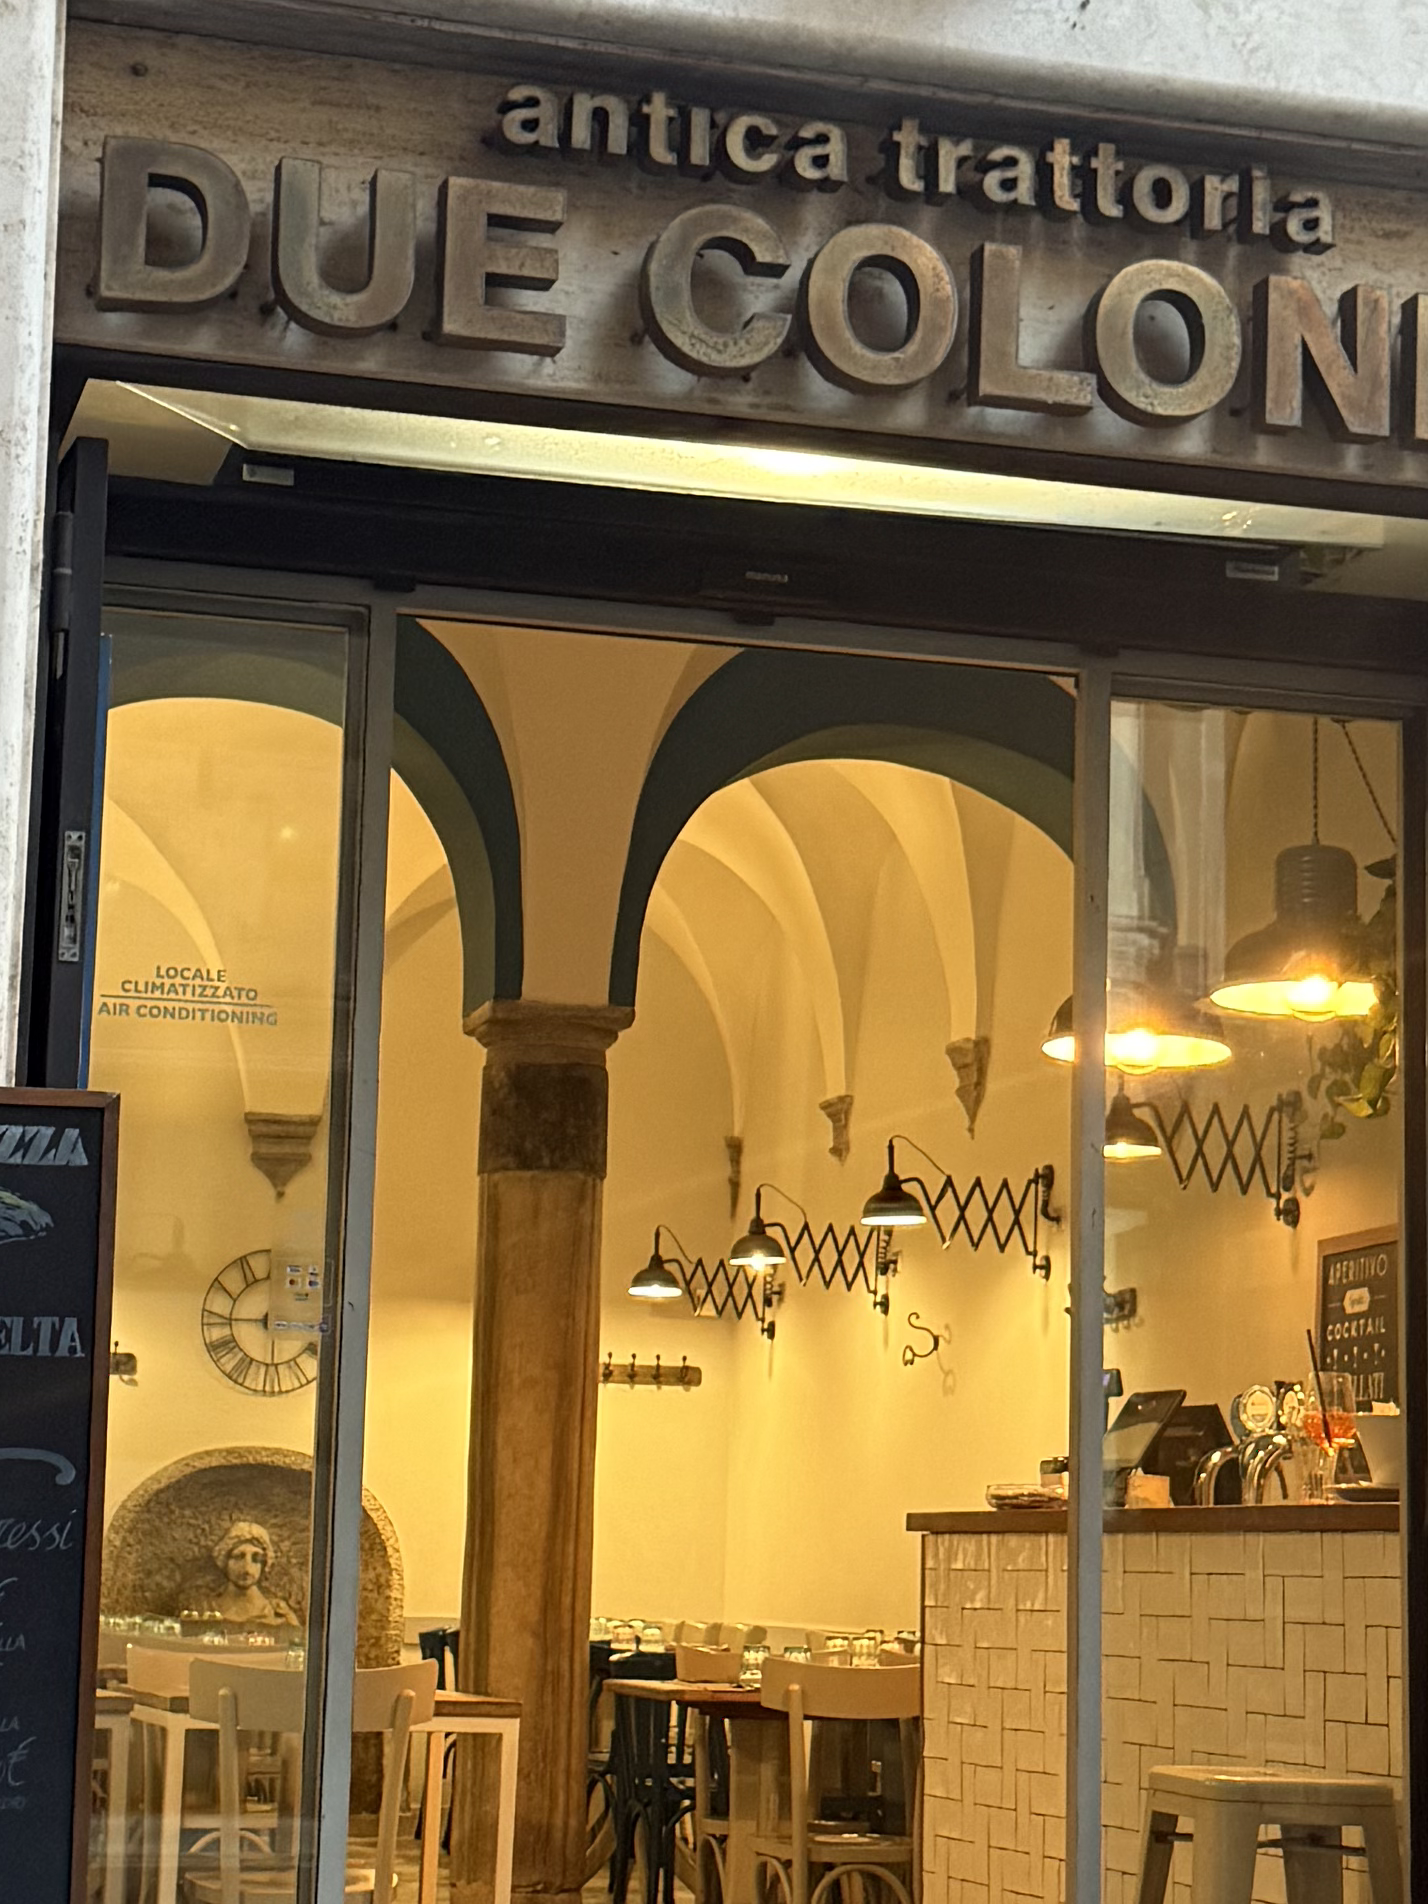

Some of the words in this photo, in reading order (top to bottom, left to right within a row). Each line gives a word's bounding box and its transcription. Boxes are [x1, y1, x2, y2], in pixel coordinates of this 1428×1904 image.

[500, 83, 849, 184] antica
[889, 116, 1337, 253] trattoria
[93, 133, 567, 357] DUE
[155, 964, 227, 983] LOCALE
[121, 979, 259, 1002] CLIMATIZZATO
[97, 1001, 130, 1018] AIR
[136, 1004, 278, 1026] CONDITIONING
[1328, 1253, 1388, 1286] APERITIVO
[1326, 1316, 1386, 1342] COCKTAIL
